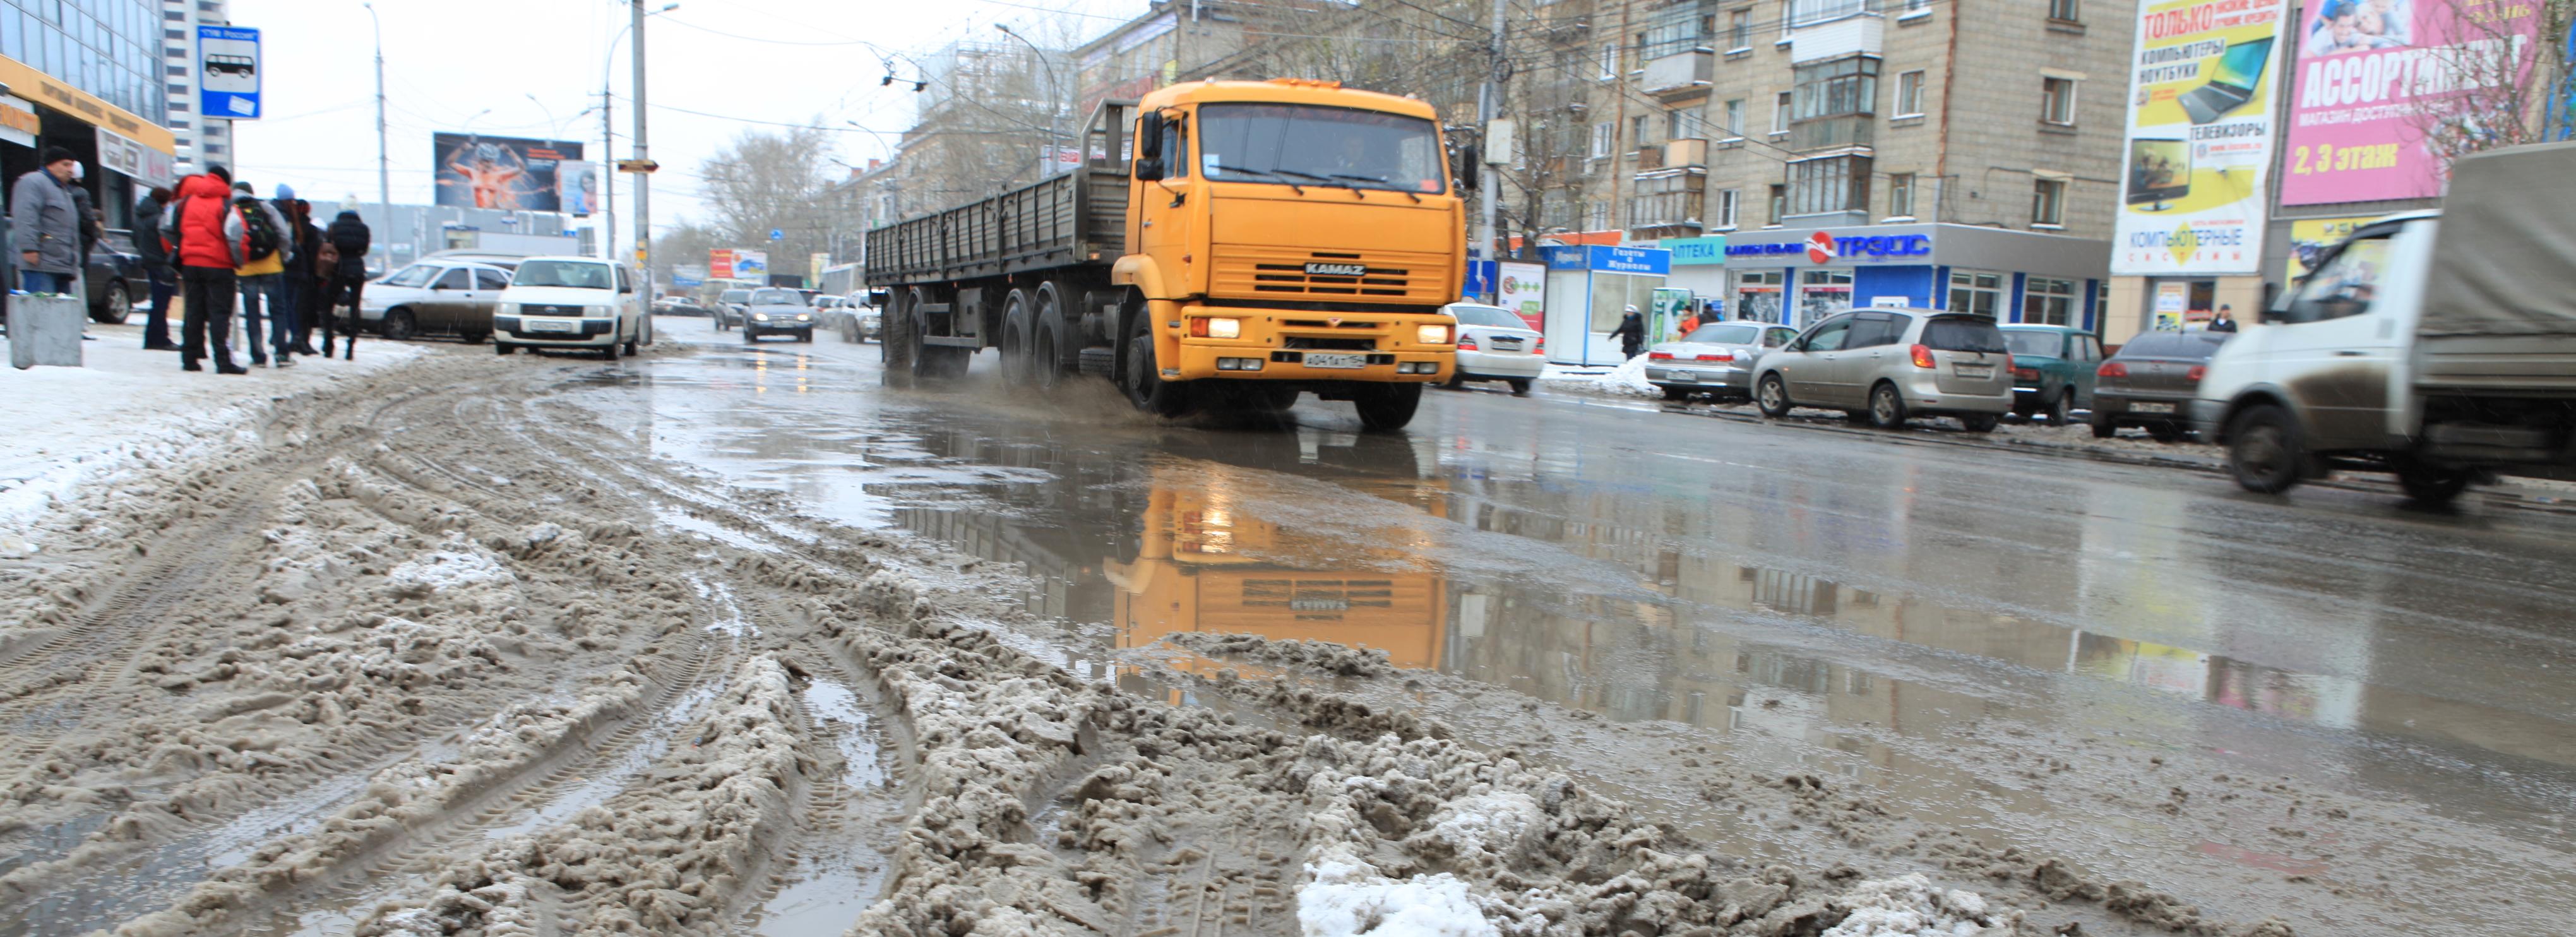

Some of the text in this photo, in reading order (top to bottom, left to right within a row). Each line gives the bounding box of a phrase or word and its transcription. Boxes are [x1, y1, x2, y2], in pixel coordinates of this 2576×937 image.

[2145, 4, 2212, 40] ТОЛЬКО
[2142, 38, 2225, 63] КОМПЬЮТЕРЫ
[2140, 63, 2198, 83] НОУТБУКИ
[2299, 109, 2352, 126] МАГАЗИН
[2190, 122, 2266, 140] ТЕЛЕВИЗОРЫ
[2293, 143, 2399, 176] 2, 3 этаж
[2130, 229, 2243, 248] КОМПЬЮТЕРНЫЕ
[1671, 244, 1715, 258] АПТЕКА
[1305, 263, 1365, 275] KAMAZ
